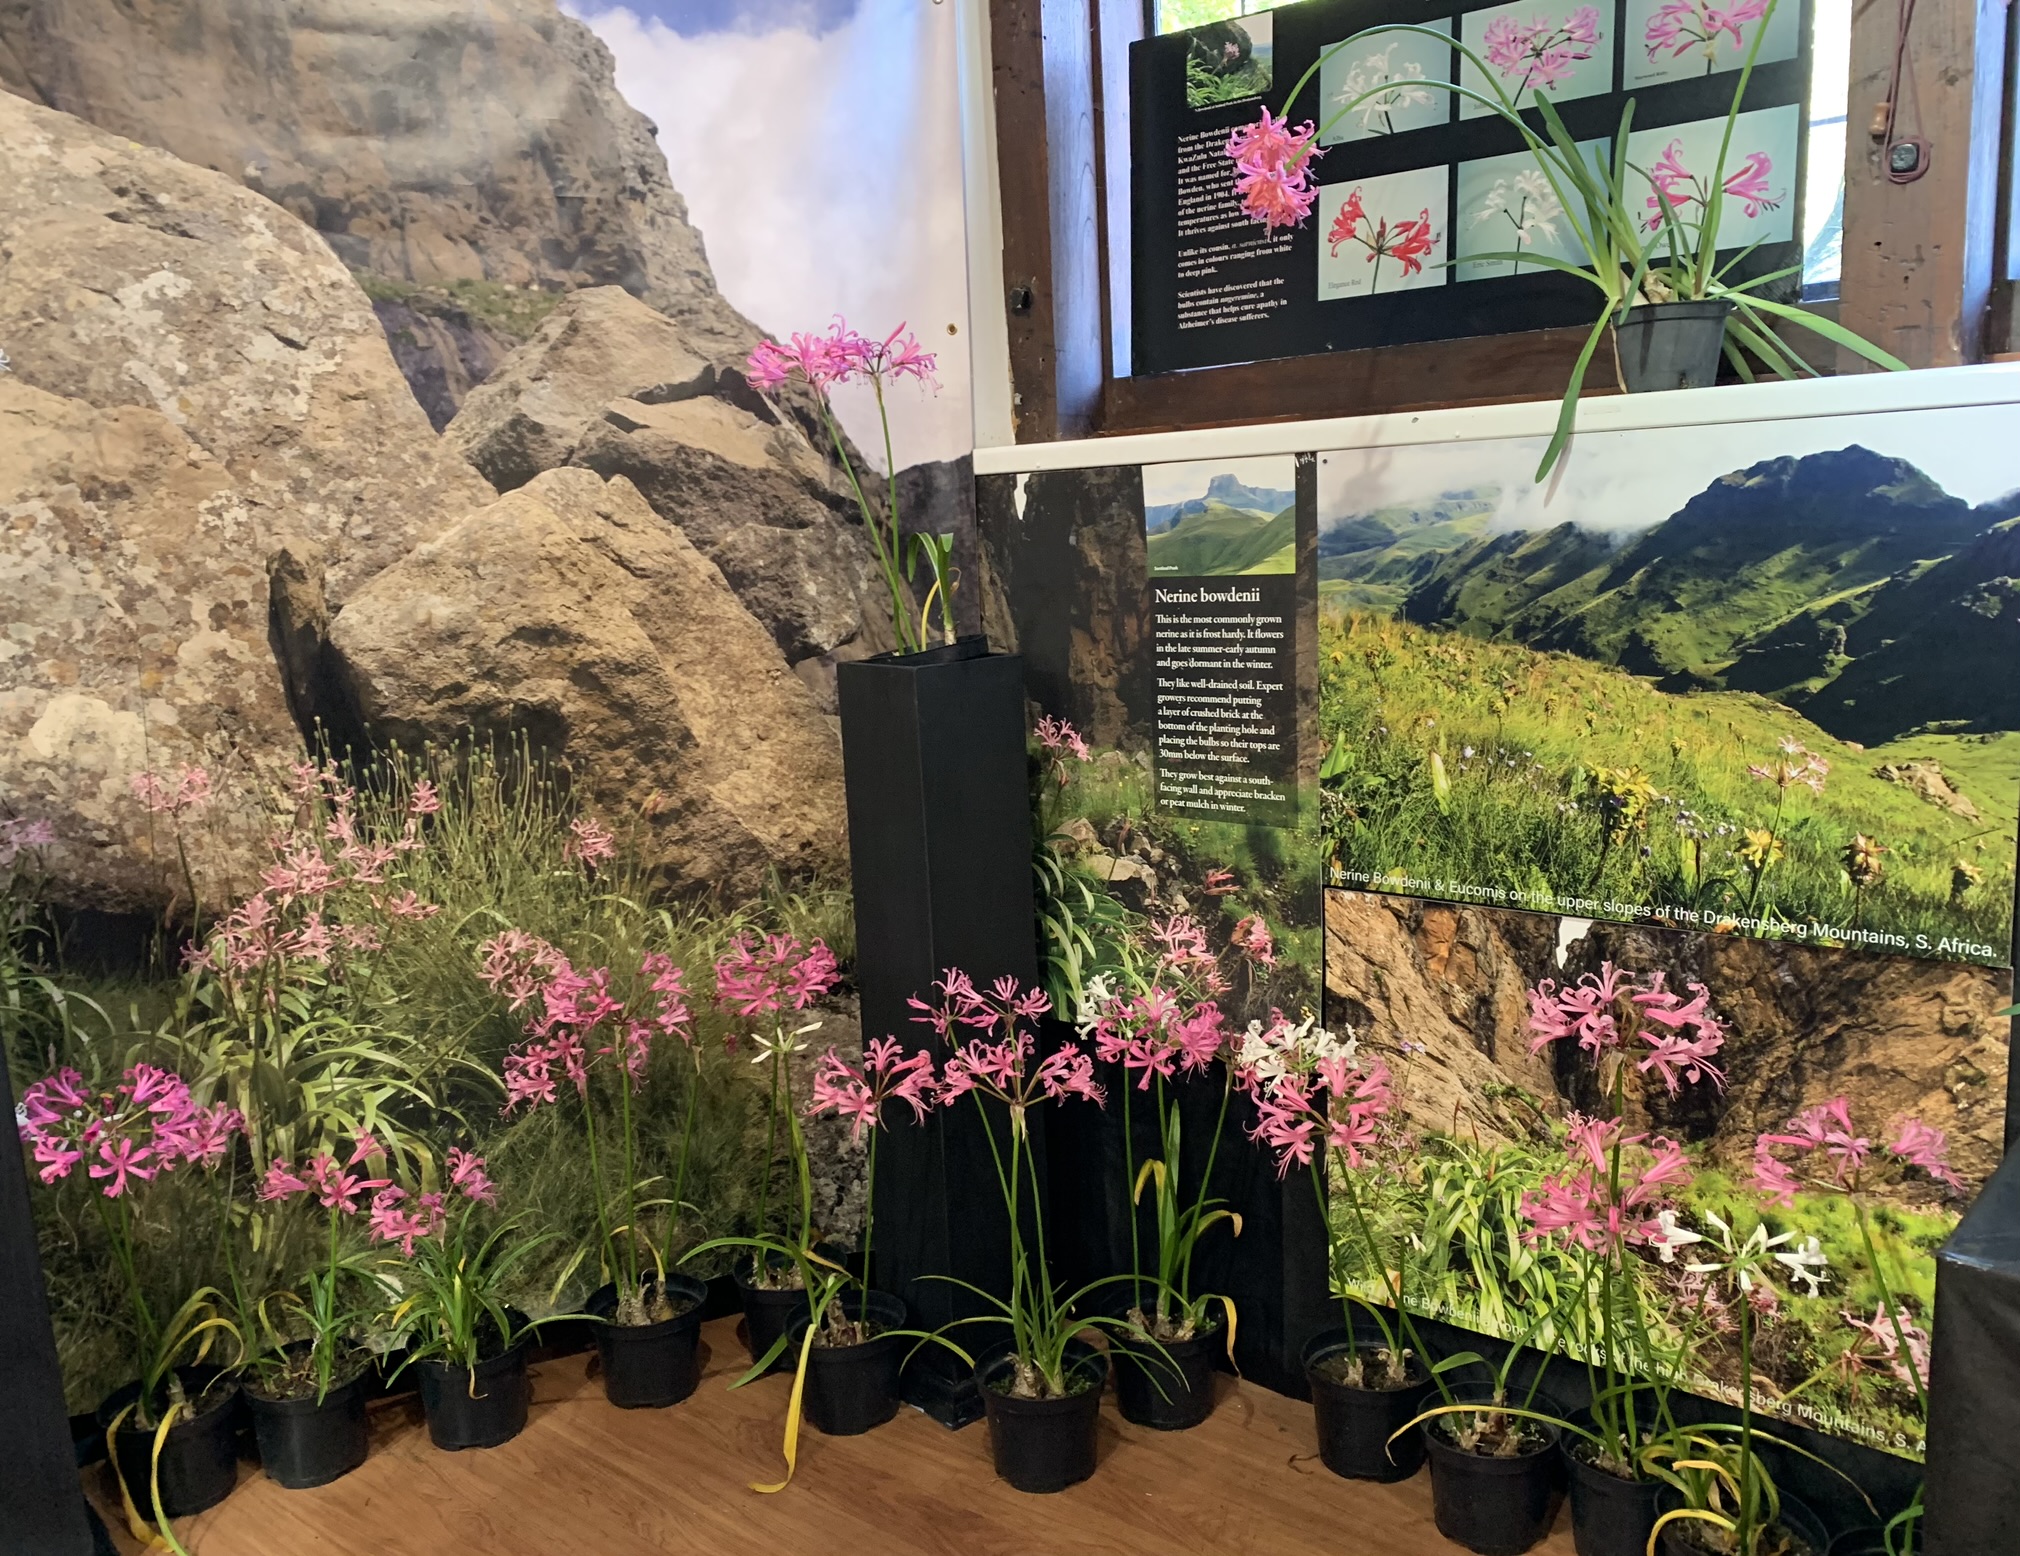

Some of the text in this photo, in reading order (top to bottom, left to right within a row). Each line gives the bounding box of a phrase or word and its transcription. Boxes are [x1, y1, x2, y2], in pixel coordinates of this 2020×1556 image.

[1178, 126, 1230, 143] Nerine Bowdenii
[1178, 145, 1193, 153] from
[1194, 142, 1204, 150] the
[1178, 152, 1207, 163] KwaZulu
[1178, 165, 1190, 174] and
[1191, 163, 1201, 172] the
[1218, 158, 1234, 167] State
[1198, 170, 1219, 181] named
[1206, 181, 1219, 189] who
[1220, 178, 1234, 187] sent
[1178, 193, 1204, 206] England
[1178, 203, 1217, 215] of the nerine
[1178, 214, 1219, 226] temperatures
[1228, 209, 1240, 217] low
[1184, 227, 1206, 235] thrives
[1208, 222, 1230, 233] against
[1231, 218, 1249, 228] south
[1178, 248, 1198, 257] Unlike
[1280, 233, 1294, 242] only
[1206, 255, 1228, 263] colours
[1230, 251, 1255, 260] ranging
[1256, 248, 1272, 256] from
[1274, 245, 1292, 253] white
[1186, 269, 1200, 277] deep
[1201, 265, 1218, 276] pink.
[1178, 277, 1284, 297] Scientists have discovered that the
[1178, 299, 1194, 308] bulbs
[1196, 297, 1218, 306] contain
[1178, 310, 1208, 318] substance
[1209, 307, 1221, 315] that
[1222, 305, 1239, 314] helps
[1256, 299, 1278, 310] apathy
[1216, 316, 1238, 324] disease
[1155, 587, 1260, 602] Nerine bowdenii
[1155, 613, 1172, 622] This
[1180, 613, 1192, 622] the
[1213, 613, 1255, 626] commonly
[1256, 617, 1282, 626] grown
[1156, 629, 1179, 637] nerine
[1189, 629, 1195, 637] it
[1196, 629, 1202, 637] is
[1203, 628, 1220, 637] frost
[1222, 628, 1245, 641] hardy.
[1247, 629, 1254, 638] It
[1255, 629, 1284, 638] flowers
[1156, 643, 1276, 656] in the late summer-early autumn
[1157, 657, 1273, 670] and goes dormant in the winter.
[1157, 678, 1283, 693] They like well-drained soil. Expert
[1157, 694, 1262, 707] growers recommend putting
[1163, 706, 1180, 719] layer
[1181, 707, 1190, 716] of
[1190, 708, 1219, 717] crushed
[1220, 708, 1240, 718] brick
[1242, 710, 1249, 718] at
[1251, 710, 1263, 719] the
[1158, 720, 1275, 736] bottom of the planting hole and
[1159, 734, 1185, 747] placing
[1186, 735, 1197, 745] the
[1199, 736, 1219, 746] bulbs
[1231, 738, 1248, 748] their
[1250, 740, 1266, 752] tops
[1159, 748, 1250, 762] 30mm below the surface.
[1160, 767, 1177, 781] They
[1179, 772, 1197, 781] grow
[1199, 770, 1213, 780] best
[1215, 774, 1241, 784] against
[1249, 775, 1274, 785] south-
[1160, 781, 1285, 801] facing wall and appreciate bracken
[1170, 798, 1185, 809] peat
[1186, 798, 1209, 809] mulch
[1211, 801, 1218, 809] in
[1220, 802, 1246, 812] winter.
[1330, 867, 1997, 957] Nerine Bowdenii & Eucomis on the upper slopes of the Drakensberg Mountains, S. Africa.
[1798, 1403, 1888, 1443] Mountains,
[1896, 1433, 1910, 1450] S.
